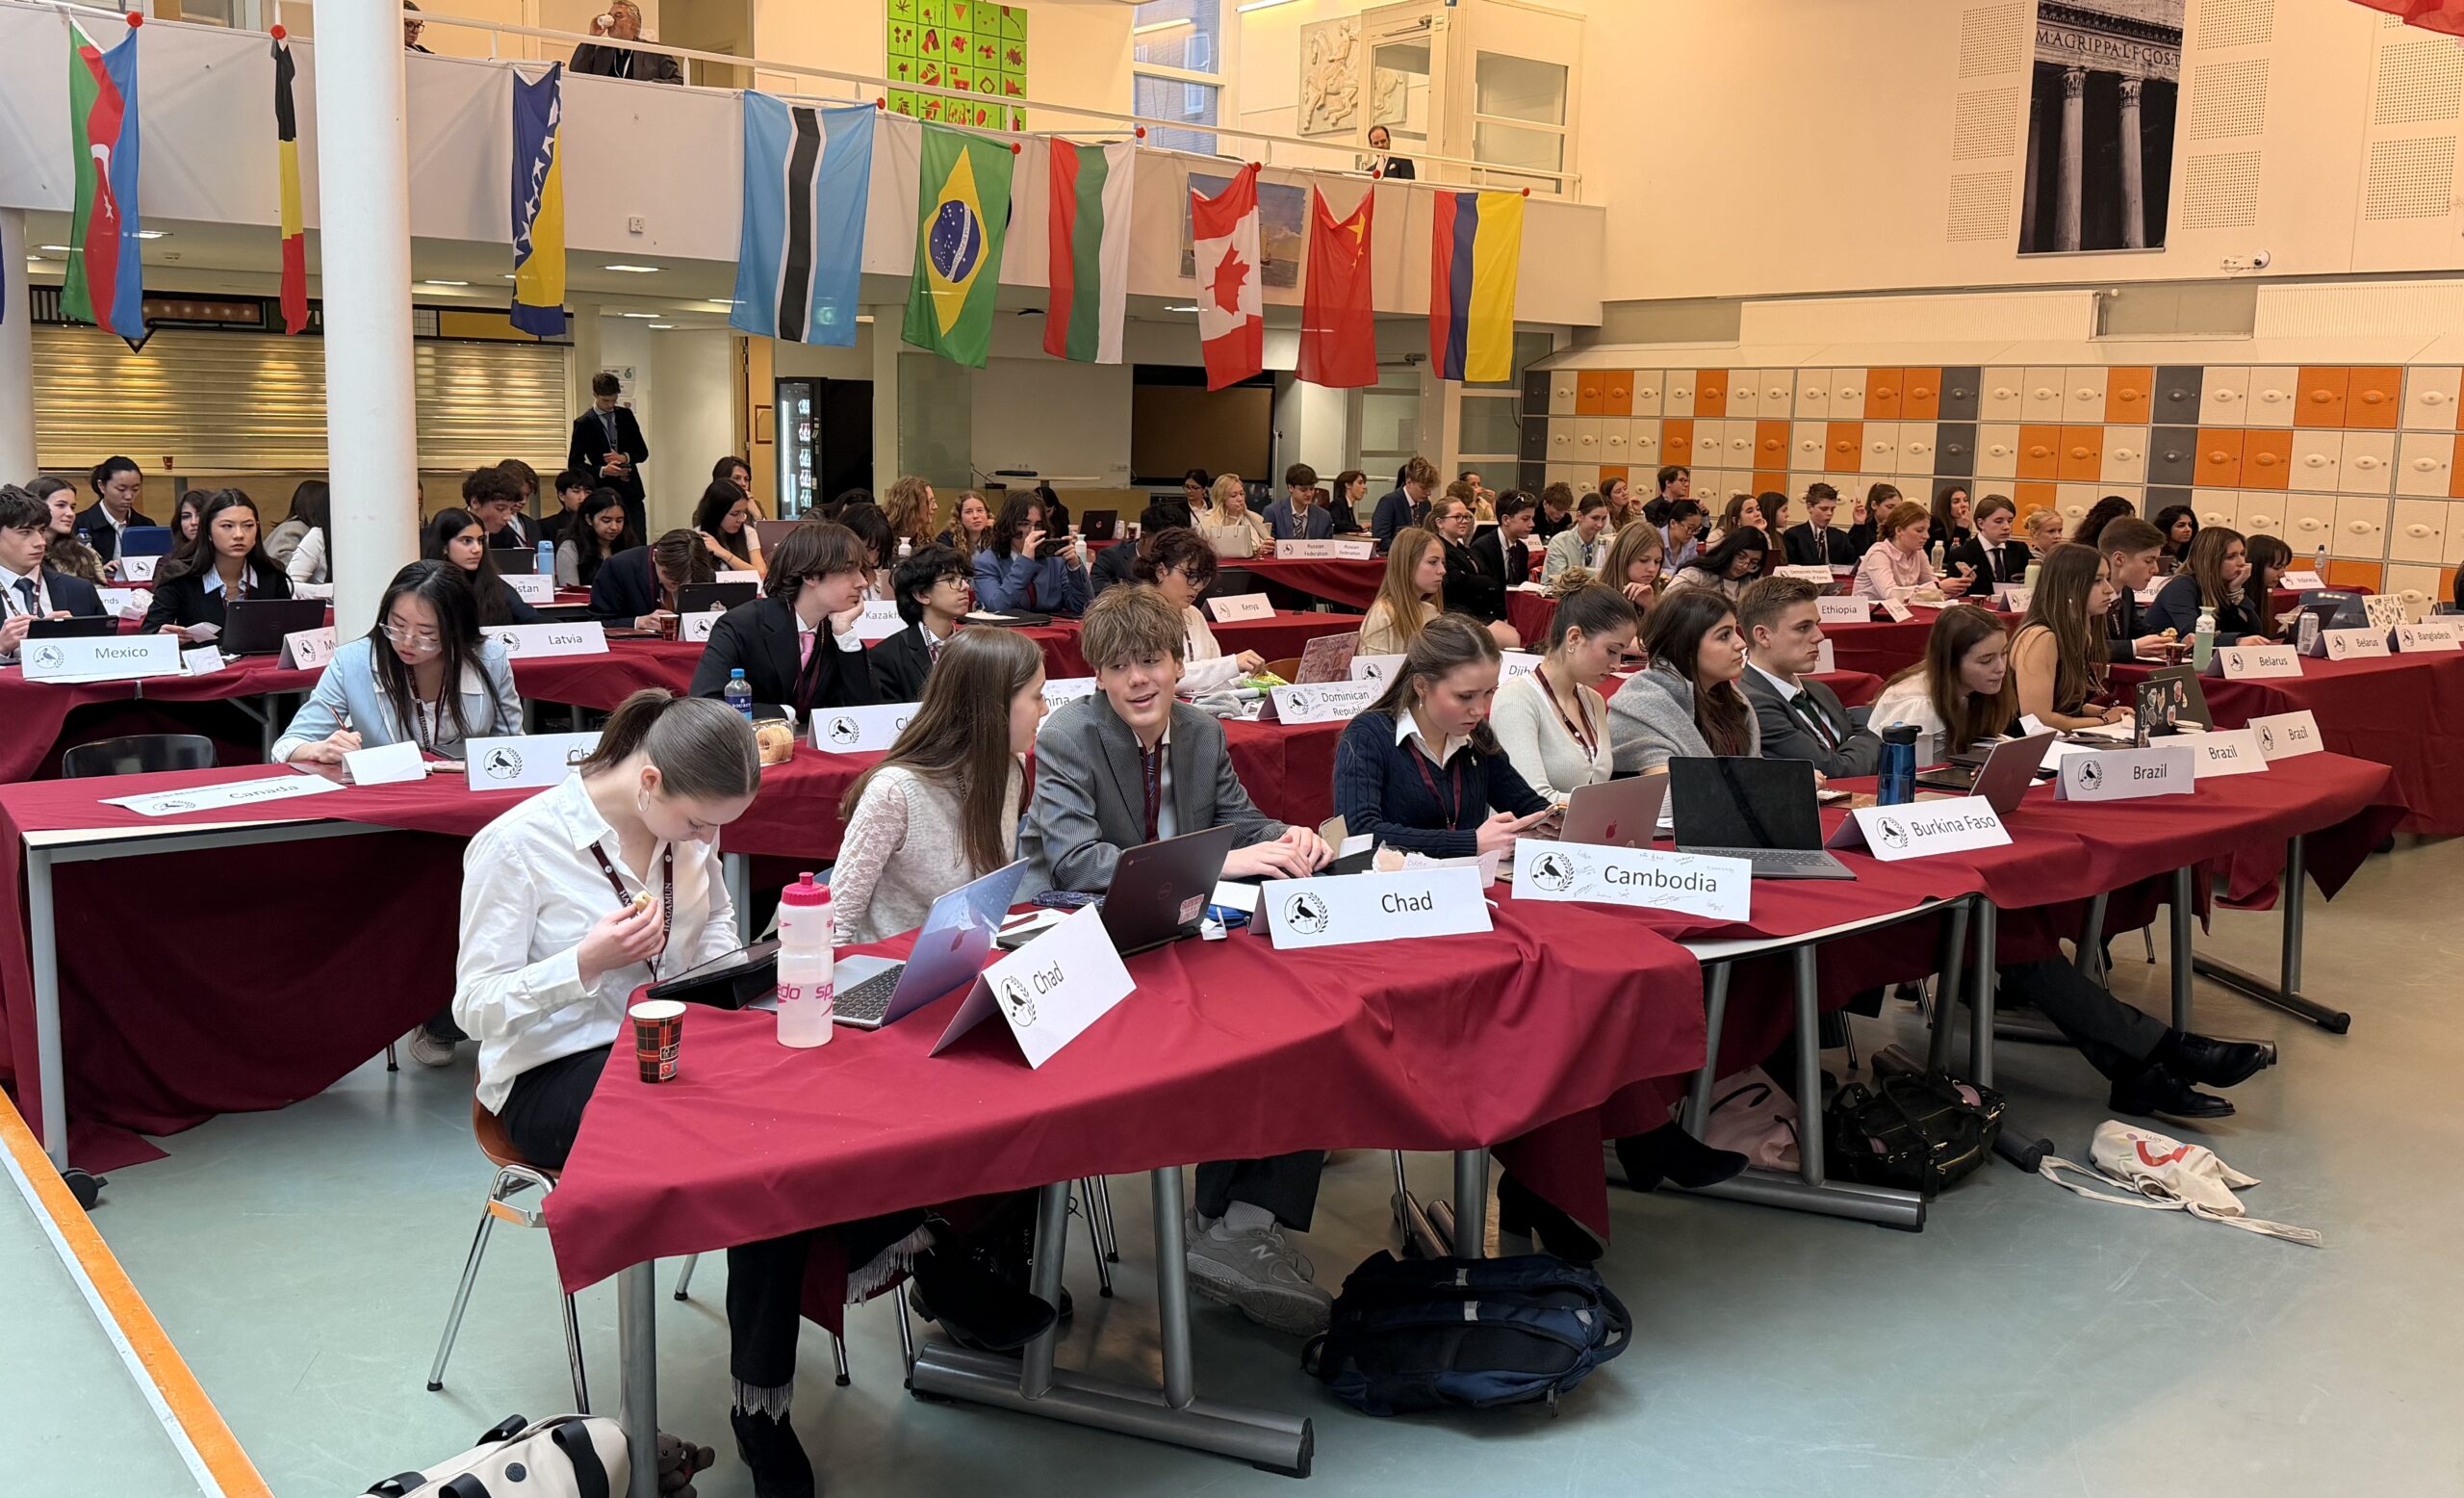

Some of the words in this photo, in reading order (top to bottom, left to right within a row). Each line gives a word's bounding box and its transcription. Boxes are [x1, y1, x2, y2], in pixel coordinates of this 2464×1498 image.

[1821, 606, 1858, 615] Ethiopia
[548, 633, 583, 645] Latvia
[2356, 638, 2379, 648] Belarus
[2417, 631, 2451, 642] Bangladesh
[95, 646, 148, 659] Mexico
[2259, 656, 2288, 667] Belarus
[1321, 690, 1371, 703] Dominican
[2288, 725, 2308, 740] Brazil
[2208, 744, 2239, 761] Brazil
[2133, 763, 2168, 781] Brazil
[229, 785, 299, 800] Canada
[1911, 818, 1965, 838] Burkina
[1964, 814, 1996, 831] Faso
[1604, 865, 1717, 893] Cambodia
[663, 883, 672, 932] HAGAMUN
[1381, 891, 1433, 914] Chad
[1033, 959, 1065, 994] Chad
